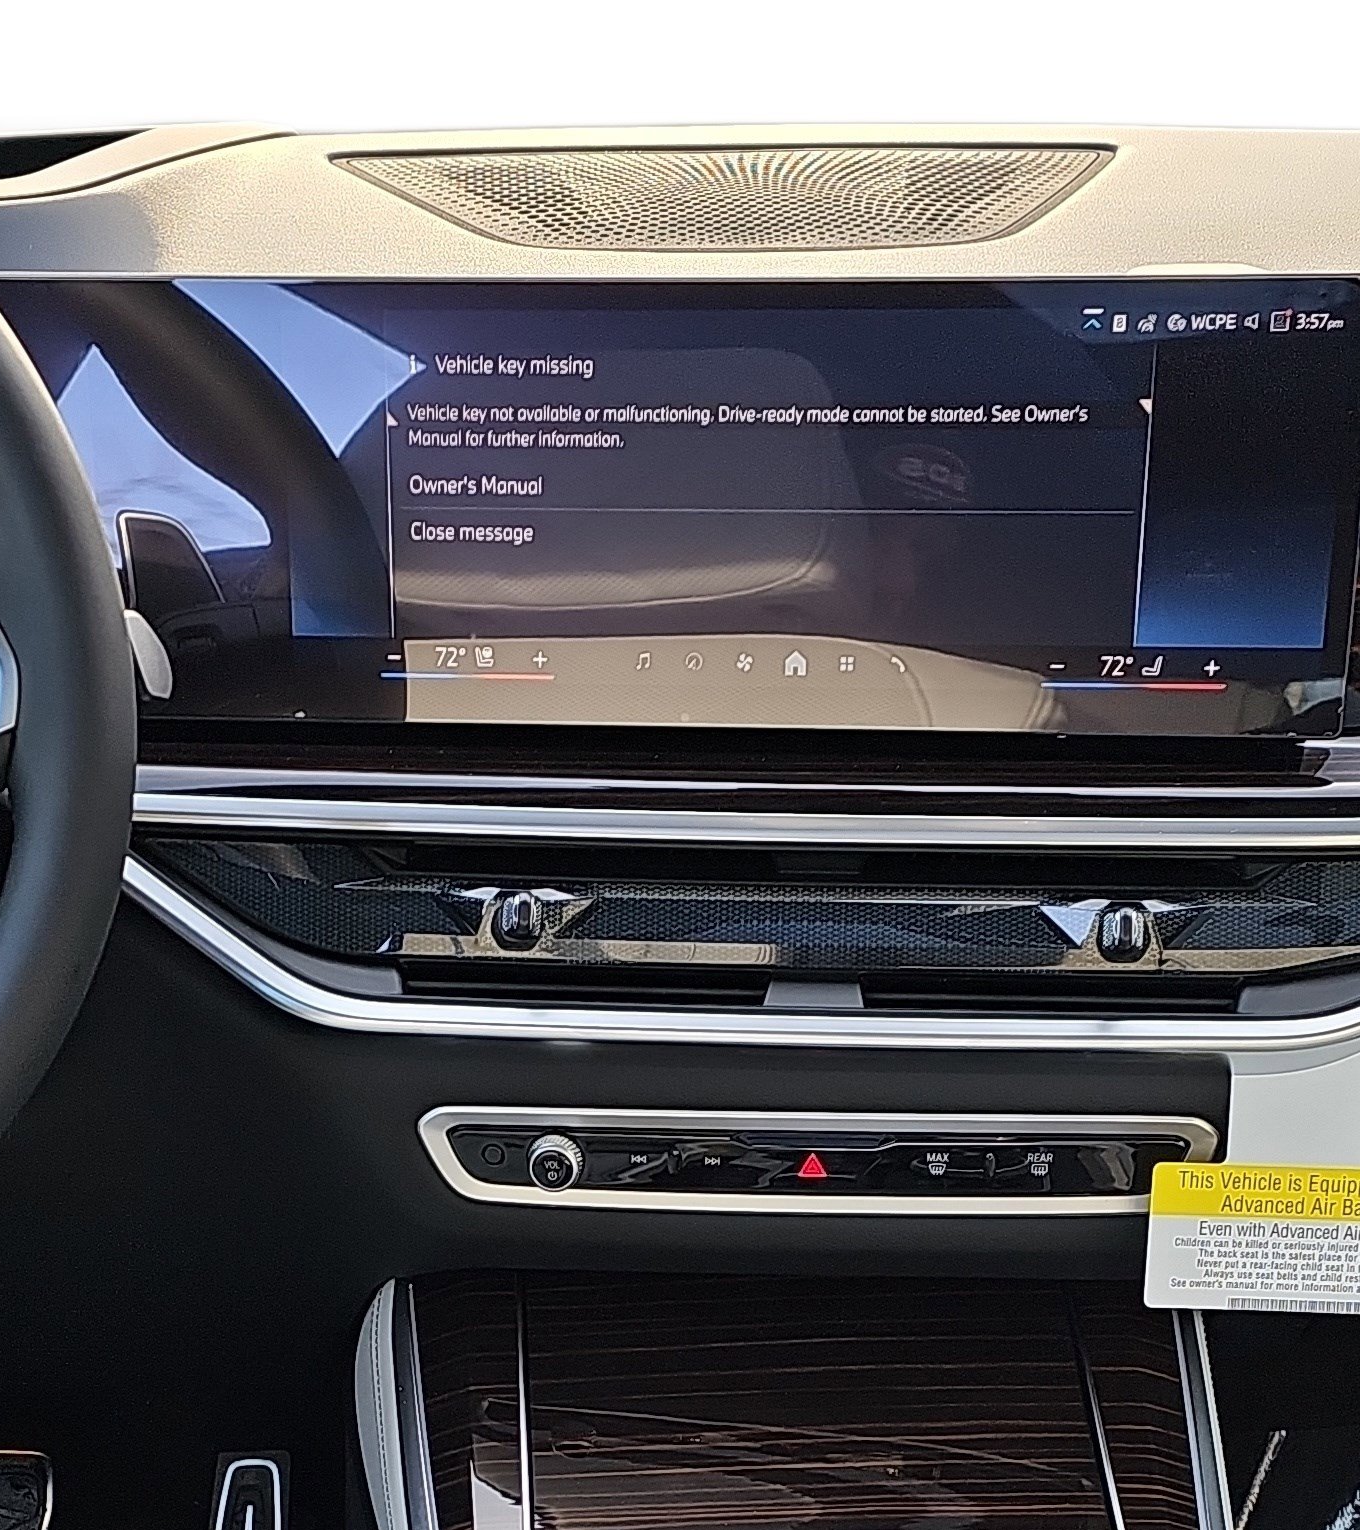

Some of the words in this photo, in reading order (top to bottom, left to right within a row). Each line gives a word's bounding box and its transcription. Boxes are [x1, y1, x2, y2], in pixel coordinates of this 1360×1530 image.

[1191, 314, 1238, 331] WCPE
[434, 354, 494, 375] Vehicle
[498, 356, 526, 379] key
[530, 356, 594, 379] missing
[406, 403, 459, 422] Vehicle
[462, 404, 487, 425] key
[490, 406, 514, 422] not
[517, 404, 581, 422] available
[585, 407, 600, 422] or
[718, 405, 804, 426] Drive-ready
[806, 405, 849, 423] mode
[853, 407, 905, 423] cannot
[907, 405, 927, 423] be
[990, 404, 1021, 423] See
[1024, 404, 1089, 423] Owner's
[408, 429, 461, 447] Manual
[465, 429, 485, 447] for
[487, 429, 535, 447] further
[409, 475, 477, 496] Owner's
[481, 475, 543, 496] Manual
[410, 521, 455, 542] Close
[459, 526, 534, 546] message
[543, 1160, 560, 1170] VOL
[926, 1153, 949, 1163] MAX
[1027, 1153, 1054, 1163] REAR
[1179, 1170, 1215, 1189] This
[1221, 1171, 1282, 1191] Vehicle
[1288, 1174, 1303, 1192] is
[1220, 1194, 1306, 1215] Advanced
[1310, 1197, 1337, 1216] Air
[1199, 1220, 1232, 1236] Even
[1236, 1222, 1266, 1238] with
[1269, 1222, 1340, 1240] Advanced
[1174, 1237, 1211, 1248] Children
[1214, 1240, 1229, 1248] can
[1232, 1239, 1243, 1248] be
[1246, 1239, 1269, 1249] killed
[1284, 1242, 1325, 1252] seriously
[1328, 1242, 1359, 1253] injured
[1199, 1248, 1215, 1258] The
[1217, 1249, 1238, 1259] back
[1240, 1250, 1259, 1259] seat
[1261, 1250, 1269, 1259] is
[1272, 1251, 1286, 1260] the
[1289, 1251, 1316, 1261] safest
[1320, 1252, 1342, 1263] place
[1345, 1253, 1358, 1262] for
[1197, 1259, 1222, 1268] Never
[1225, 1260, 1239, 1270] put
[1242, 1261, 1247, 1269] a
[1250, 1261, 1298, 1272] rear-facing
[1300, 1262, 1322, 1272] child
[1325, 1264, 1344, 1273] seat
[1347, 1264, 1355, 1273] in
[1203, 1269, 1234, 1280] Always
[1237, 1271, 1253, 1279] use
[1256, 1271, 1274, 1280] seat
[1277, 1271, 1298, 1281] belts
[1301, 1272, 1317, 1281] and
[1320, 1272, 1342, 1282] child
[1170, 1278, 1186, 1287] See
[1189, 1279, 1223, 1288] owner's
[1225, 1280, 1258, 1290] manual
[1260, 1281, 1273, 1290] for
[1276, 1282, 1299, 1291] more
[1302, 1282, 1353, 1293] information
